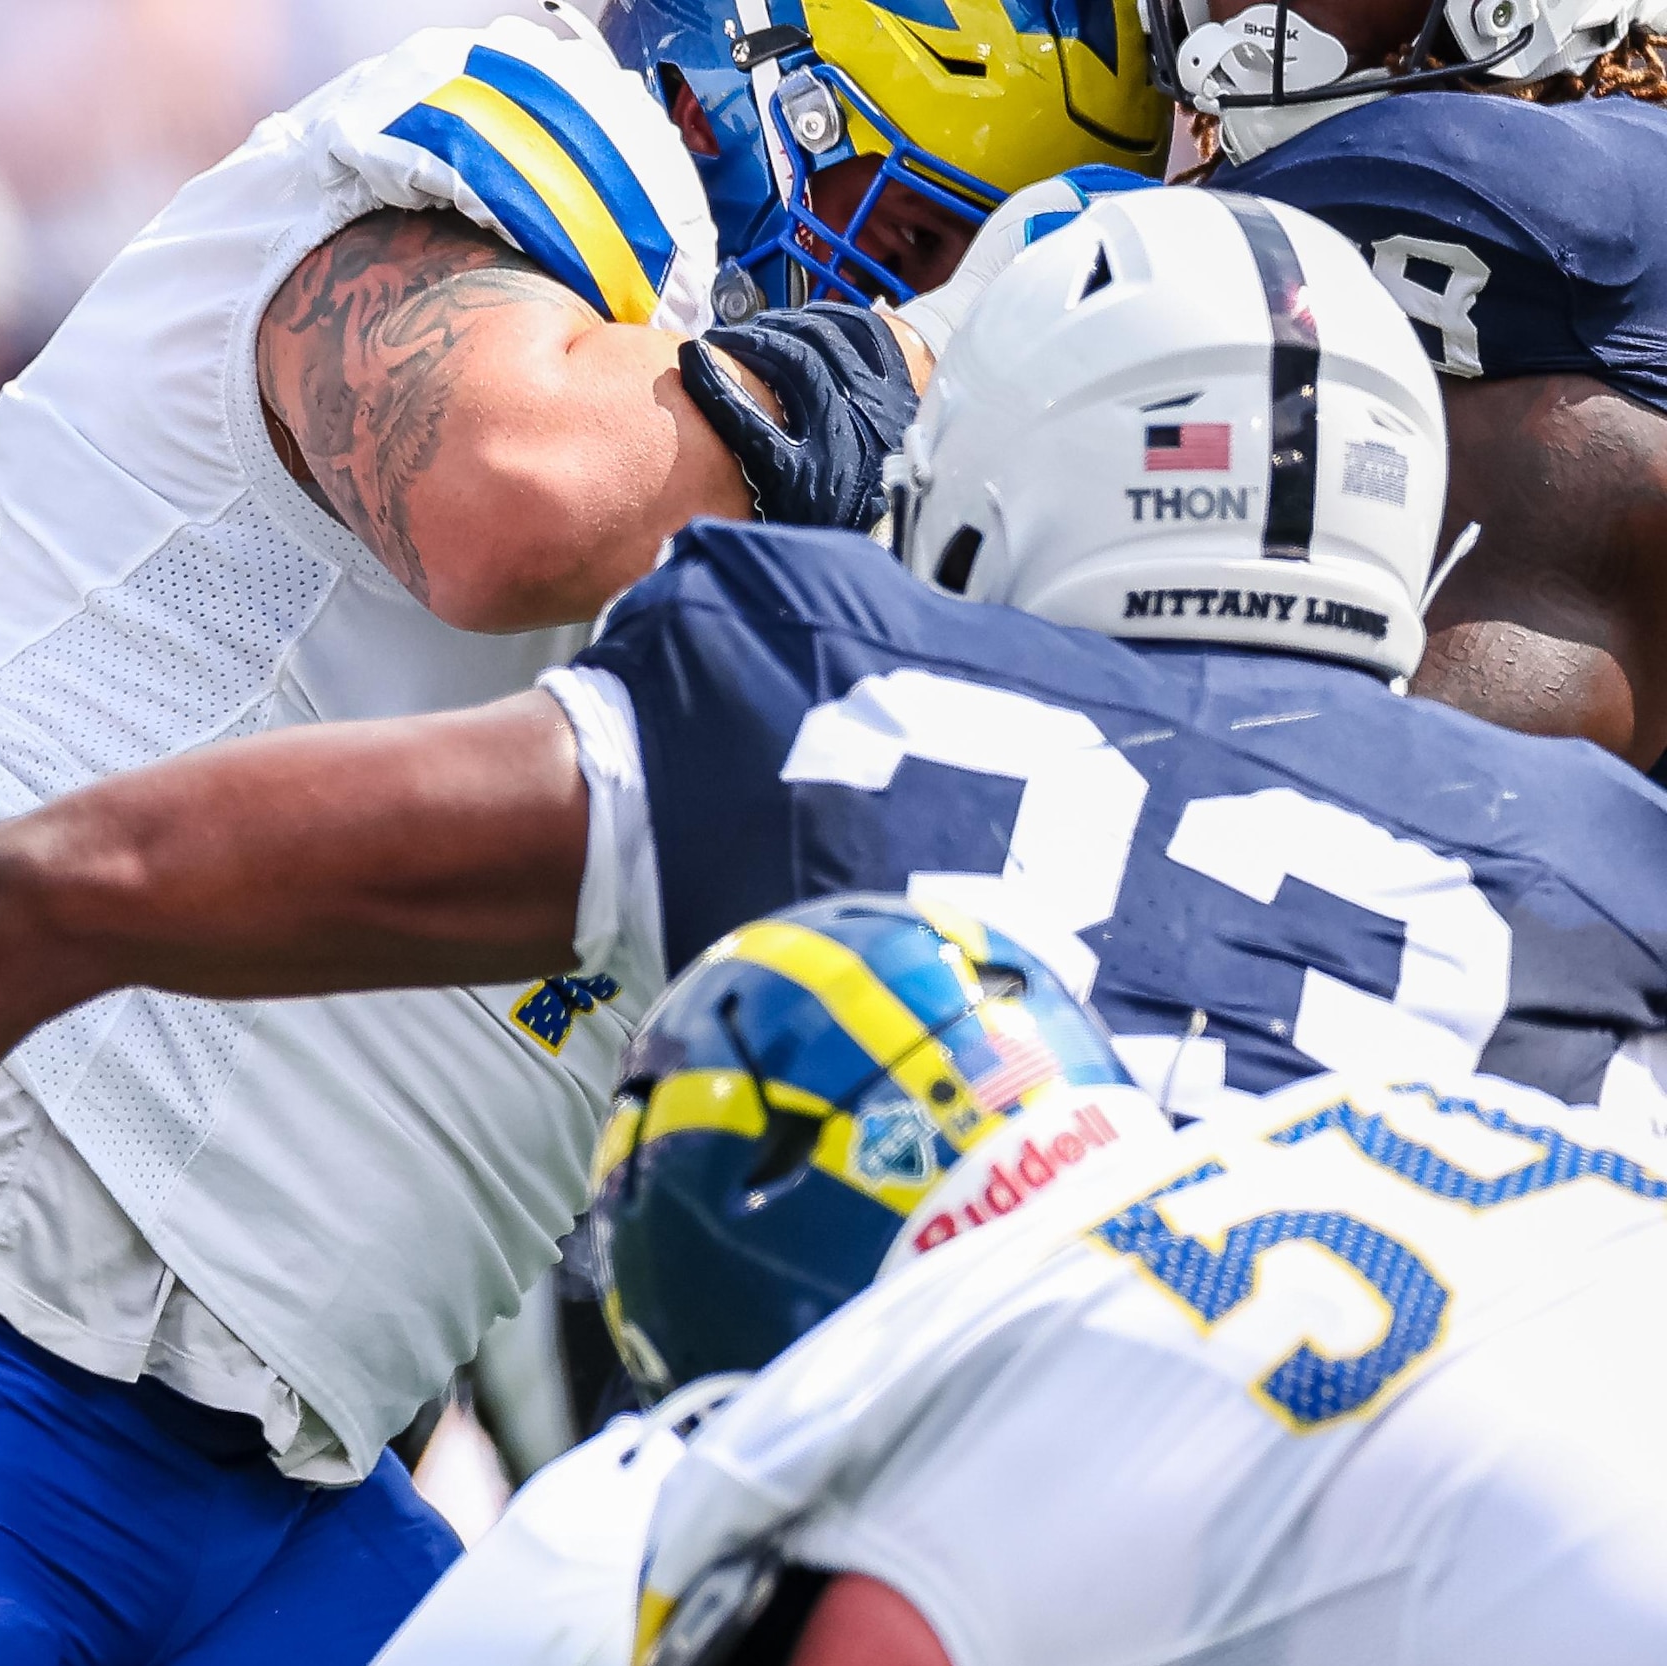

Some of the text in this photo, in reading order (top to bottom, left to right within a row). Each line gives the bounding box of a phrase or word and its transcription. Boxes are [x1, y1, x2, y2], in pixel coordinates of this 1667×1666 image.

[1244, 22, 1300, 41] SHOK
[1124, 486, 1249, 521] THON
[1122, 587, 1299, 622] NITTANY
